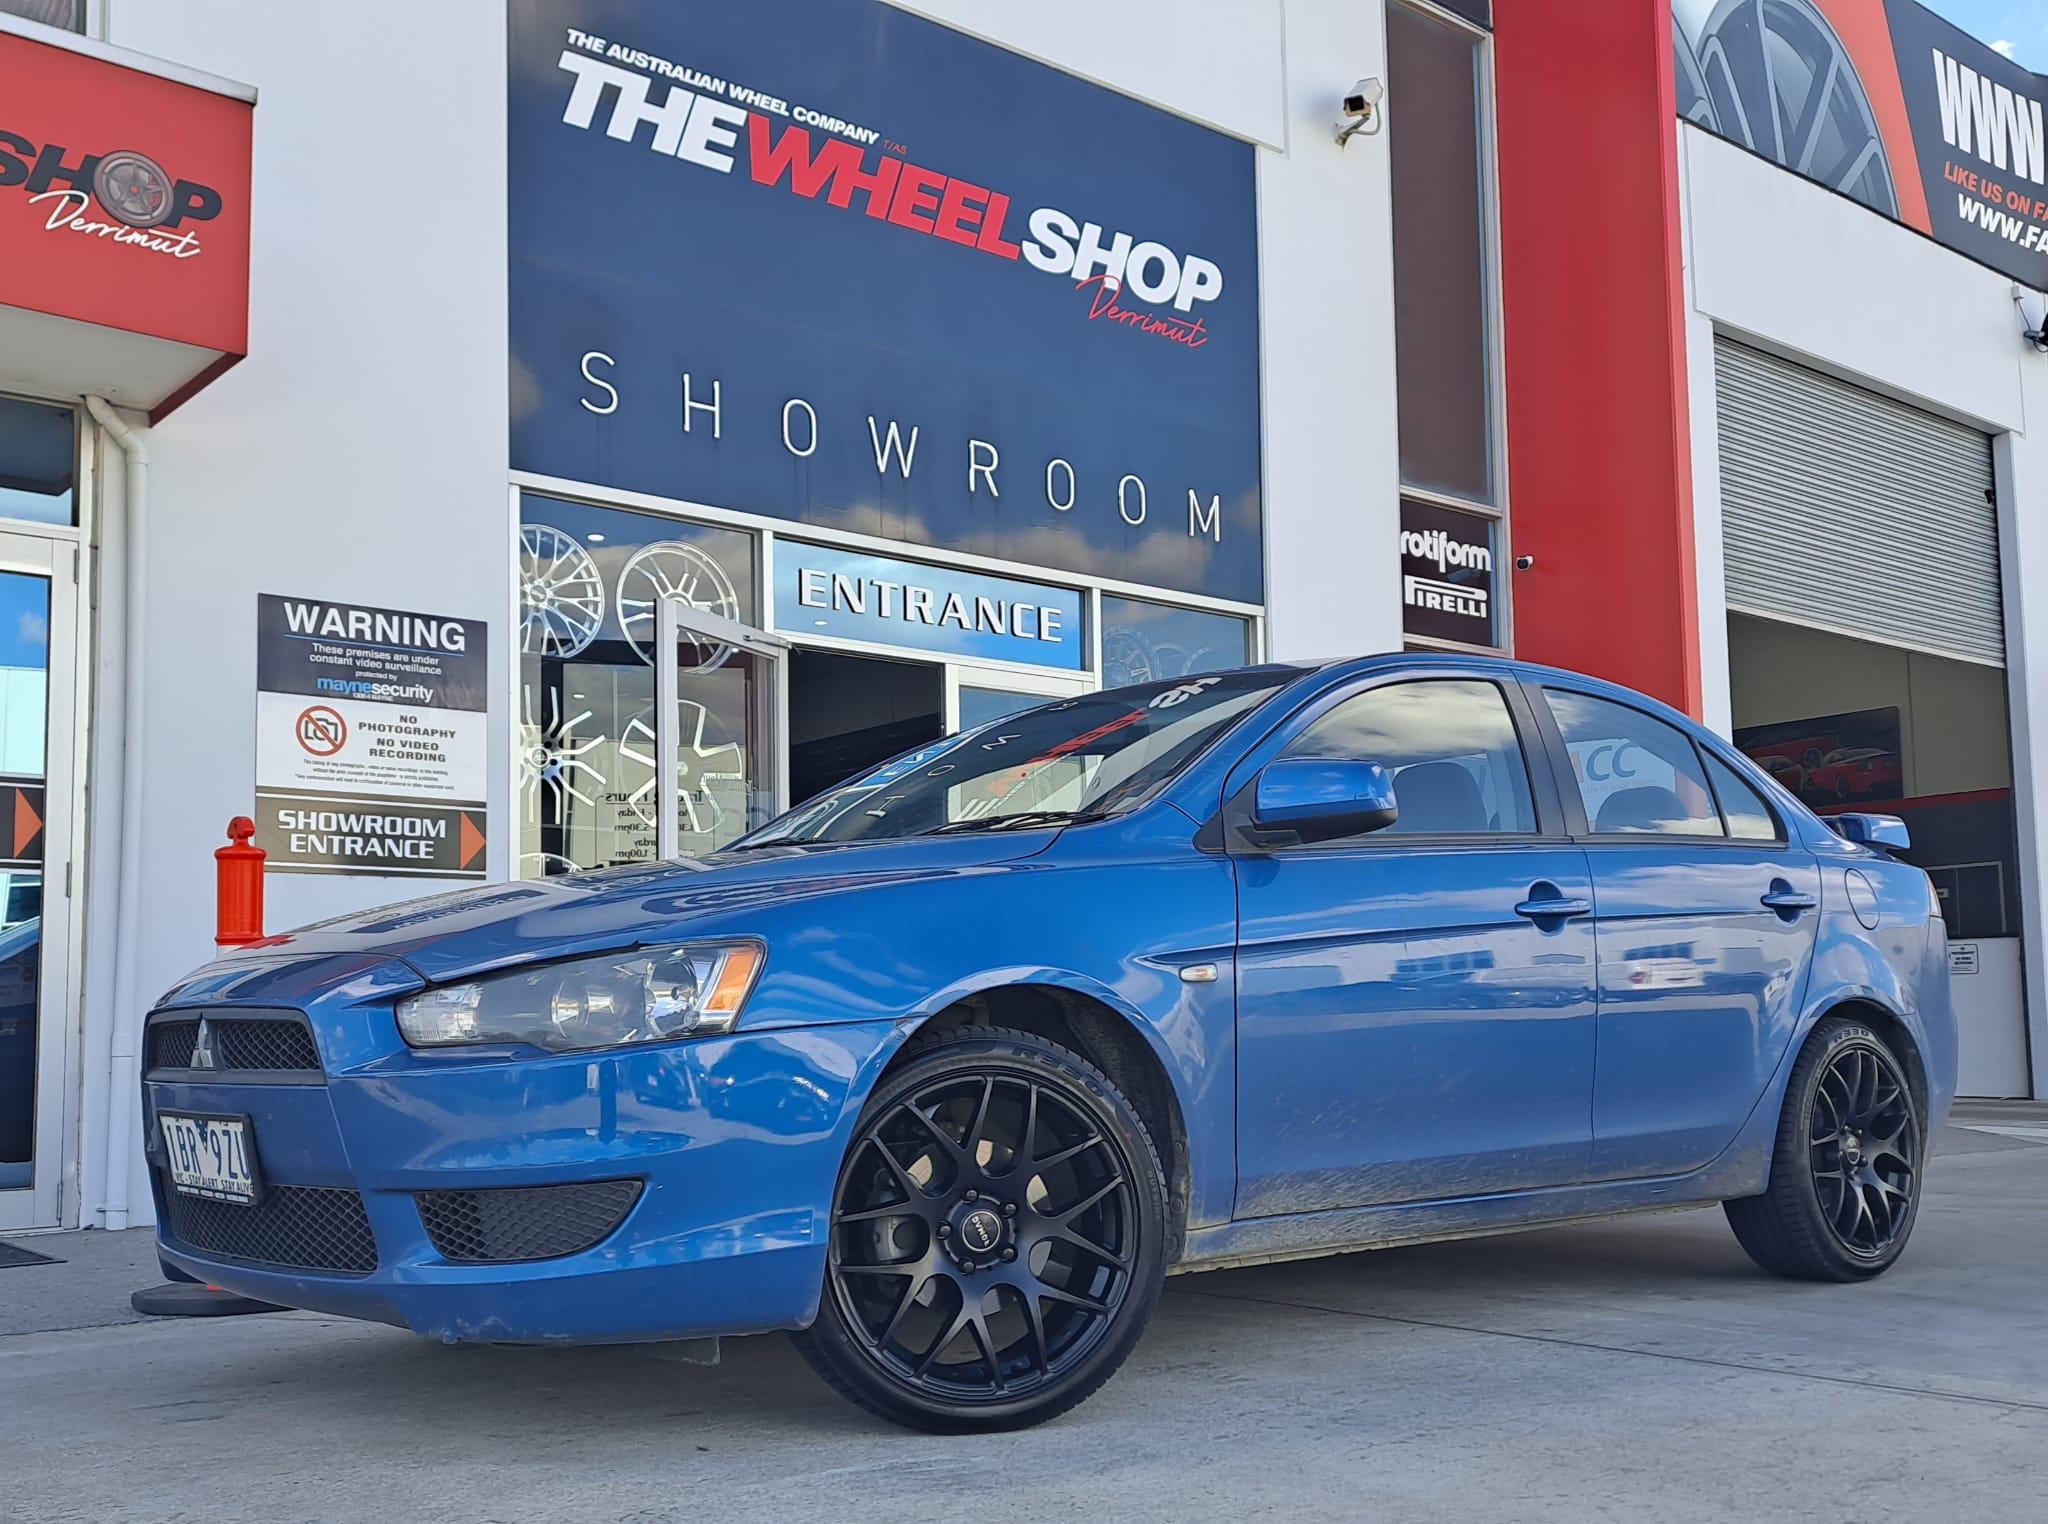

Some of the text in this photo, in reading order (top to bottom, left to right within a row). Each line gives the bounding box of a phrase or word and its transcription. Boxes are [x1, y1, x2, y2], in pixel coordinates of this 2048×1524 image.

[567, 28, 908, 155] THE AUSTRALIAN WHEEL COMPANY T/AS
[1932, 47, 2045, 186] WWW
[1944, 160, 1978, 192] LIKE
[1980, 179, 2004, 204] US
[2006, 191, 2031, 216] ON
[29, 189, 201, 258] Derrimut
[1074, 274, 1209, 348] Derrimut
[1401, 530, 1493, 573] rotiform
[798, 566, 1064, 643] ENTRANCE
[1404, 575, 1488, 618] PIRELLI
[283, 601, 466, 651] WARNING
[309, 653, 442, 675] constant video surveillance
[312, 642, 439, 666] These premises are under
[358, 722, 456, 739] PHOTOGRAPHY
[399, 714, 418, 725] NO
[369, 748, 446, 763] RECORDING
[376, 738, 439, 751] NO VIDEO
[278, 809, 447, 839] SHOWROOM
[290, 833, 434, 860] ENTRANCE
